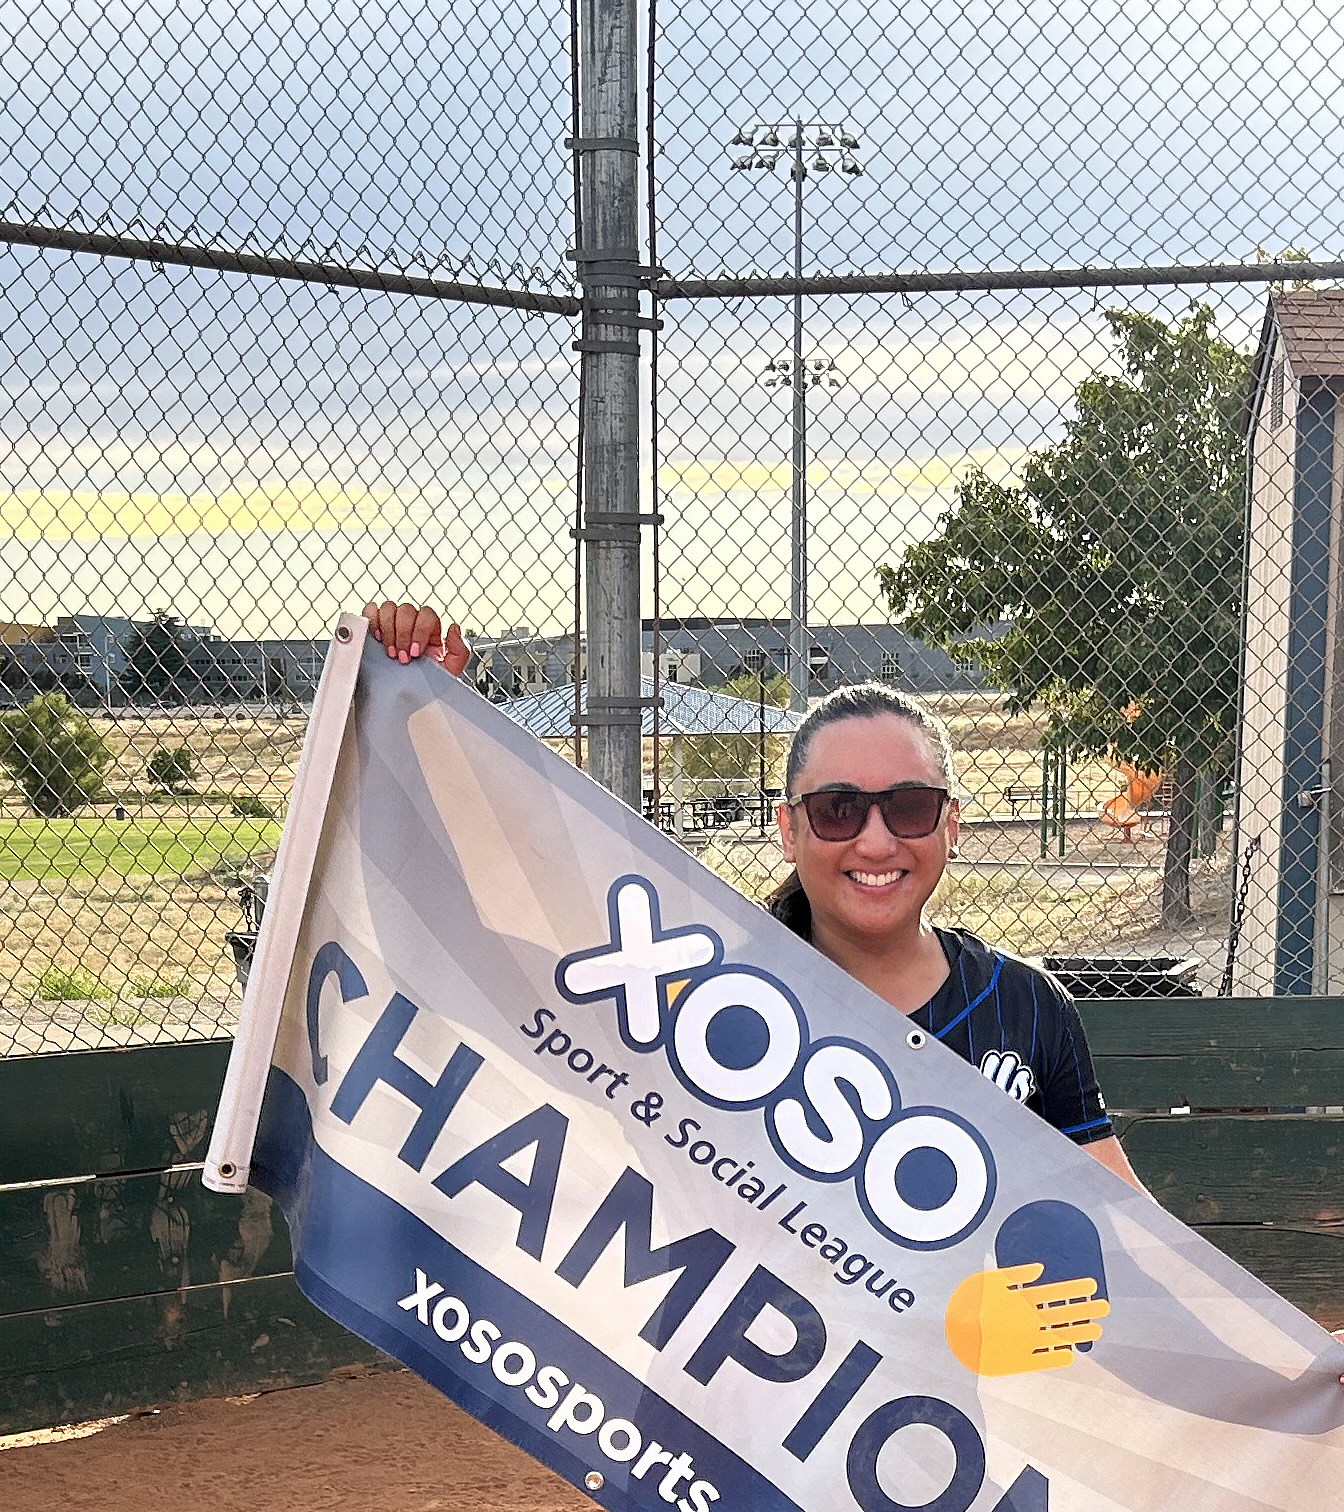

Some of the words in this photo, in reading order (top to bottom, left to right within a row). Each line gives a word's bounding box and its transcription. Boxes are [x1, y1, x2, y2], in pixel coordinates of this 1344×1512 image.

[519, 1007, 630, 1100] Sport
[630, 1090, 665, 1128] &
[663, 1116, 788, 1212] Social
[777, 1201, 916, 1315] League
[555, 874, 997, 1251] XOSO
